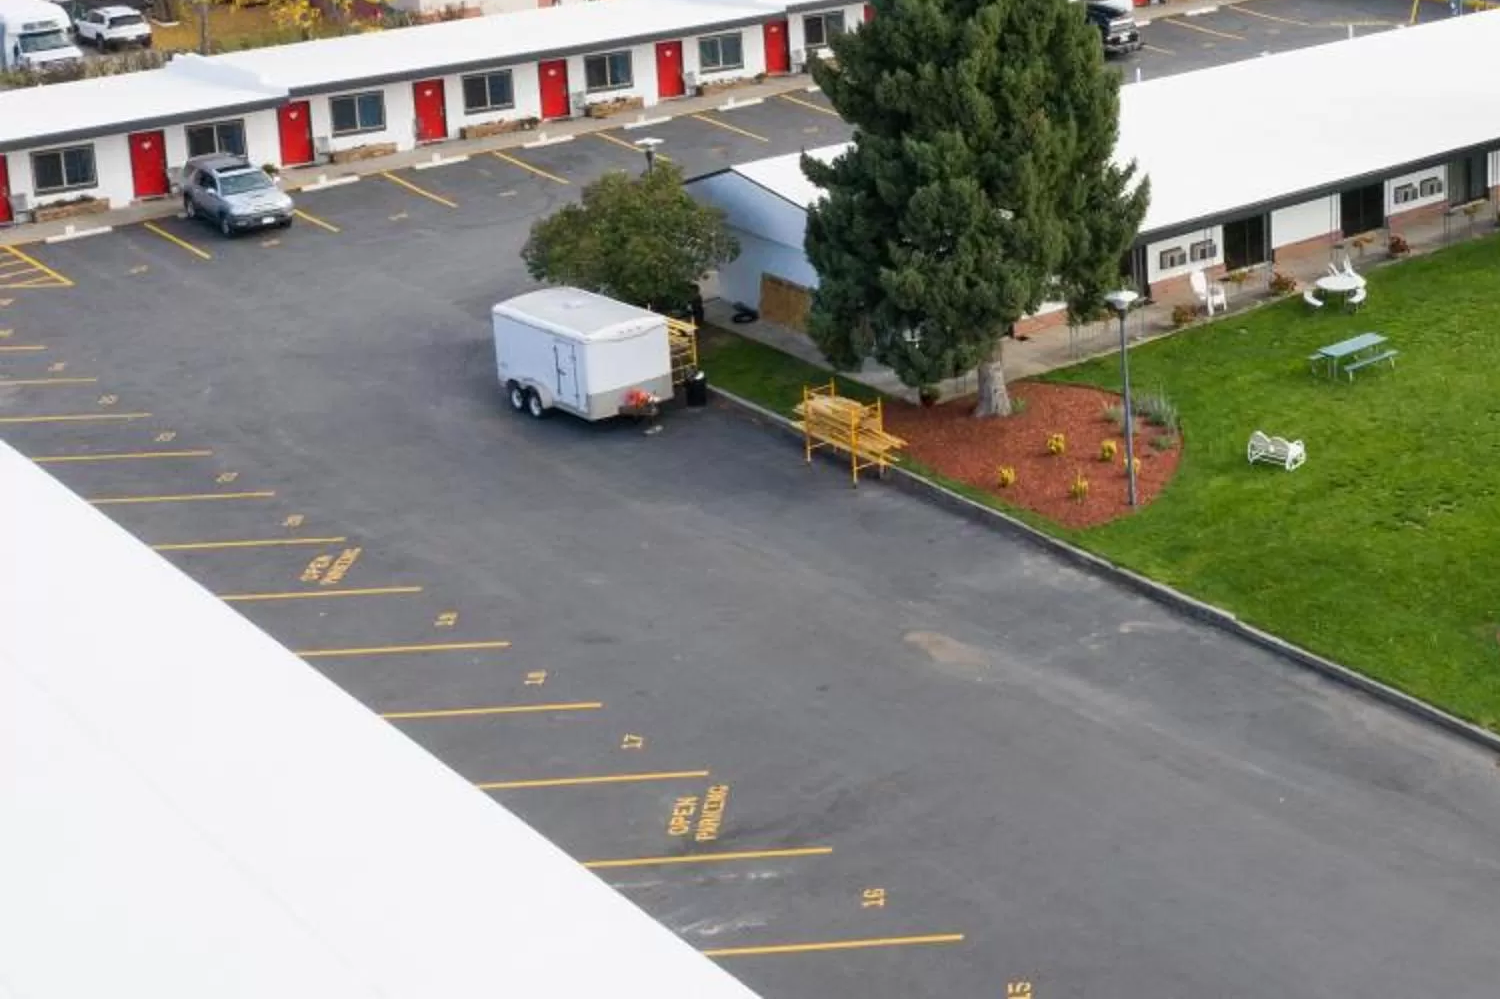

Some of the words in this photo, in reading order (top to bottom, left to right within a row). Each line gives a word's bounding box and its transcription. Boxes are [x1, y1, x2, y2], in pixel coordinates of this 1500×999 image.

[620, 732, 644, 750] 17
[668, 796, 698, 836] OPEN
[695, 784, 729, 842] PARKING
[861, 887, 885, 908] 16
